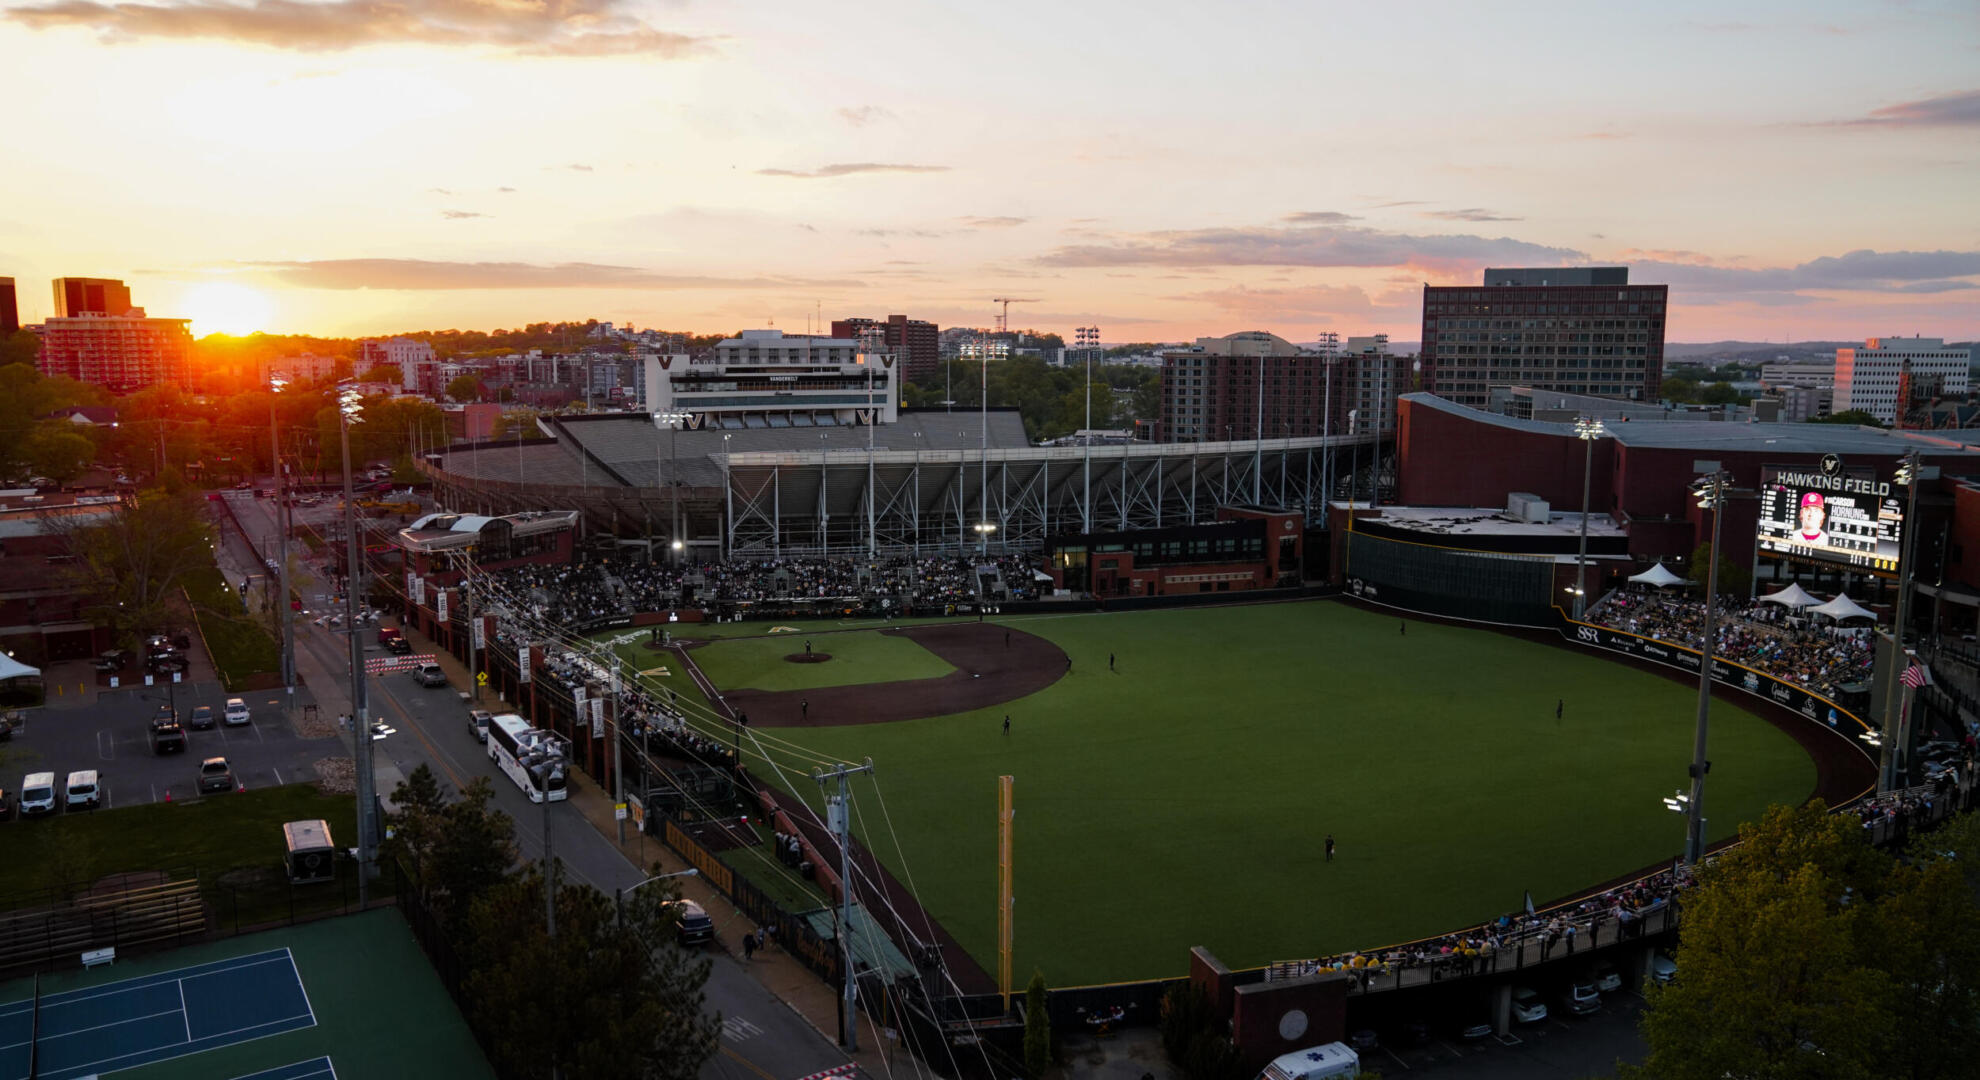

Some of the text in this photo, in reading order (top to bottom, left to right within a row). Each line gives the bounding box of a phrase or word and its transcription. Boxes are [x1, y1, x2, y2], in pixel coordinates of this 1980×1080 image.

[1777, 471, 1890, 496] HAWKINS FIELD
[1831, 505, 1865, 520] HORNUNG
[1577, 625, 1601, 644] SSR
